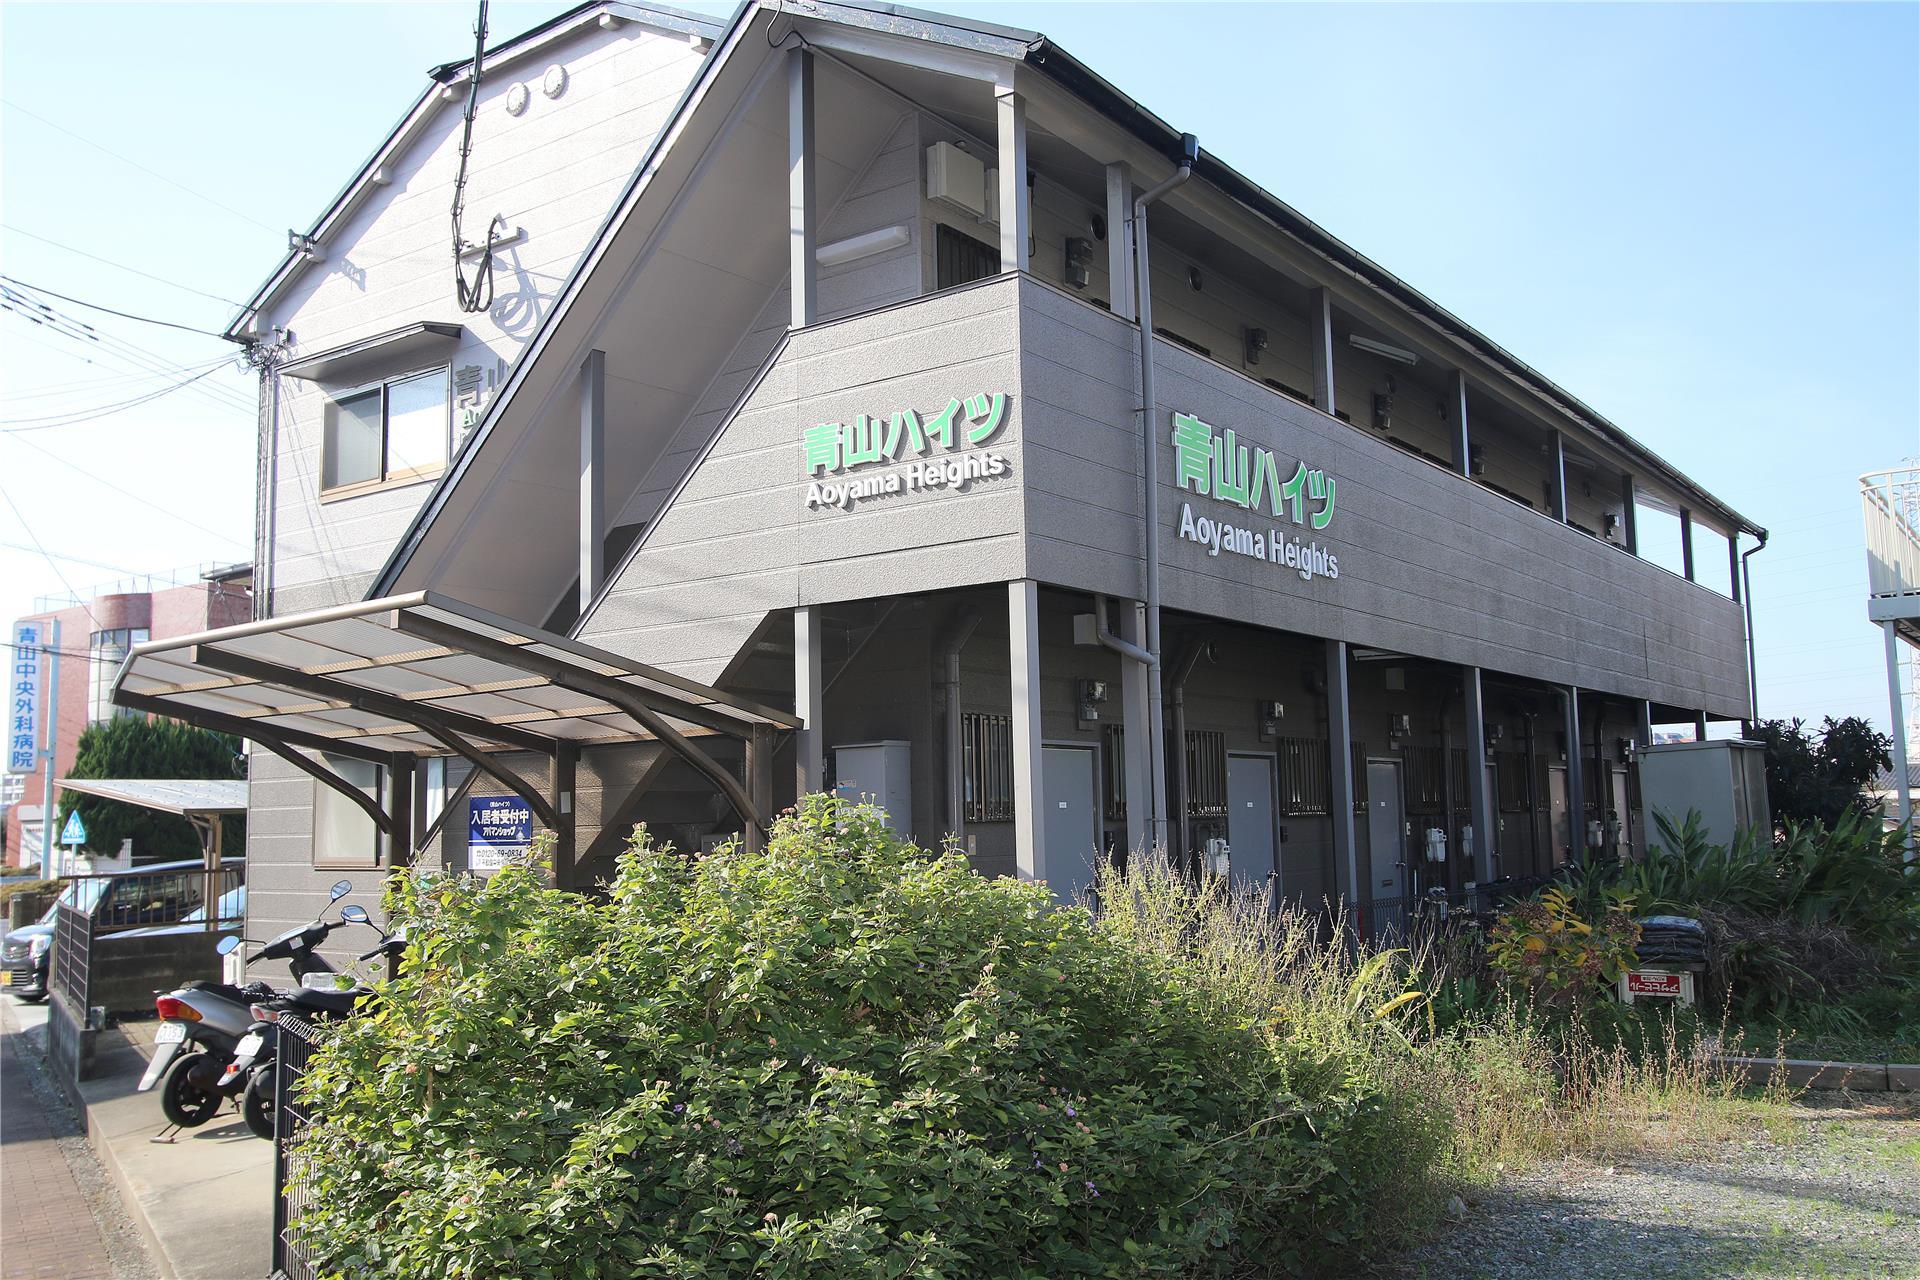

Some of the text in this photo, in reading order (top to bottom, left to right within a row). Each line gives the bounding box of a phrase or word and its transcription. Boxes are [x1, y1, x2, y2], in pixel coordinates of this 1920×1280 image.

[803, 391, 1007, 476] 青山ハイツ
[1172, 411, 1336, 530] 青山ハイツ
[804, 453, 1006, 508] Aoyama Heights
[1179, 503, 1339, 581] Aoyama Heights
[12, 627, 37, 768] 青山中央外科病院
[471, 808, 529, 825] 入居者受付中
[1630, 982, 1679, 992] アサヒビール
